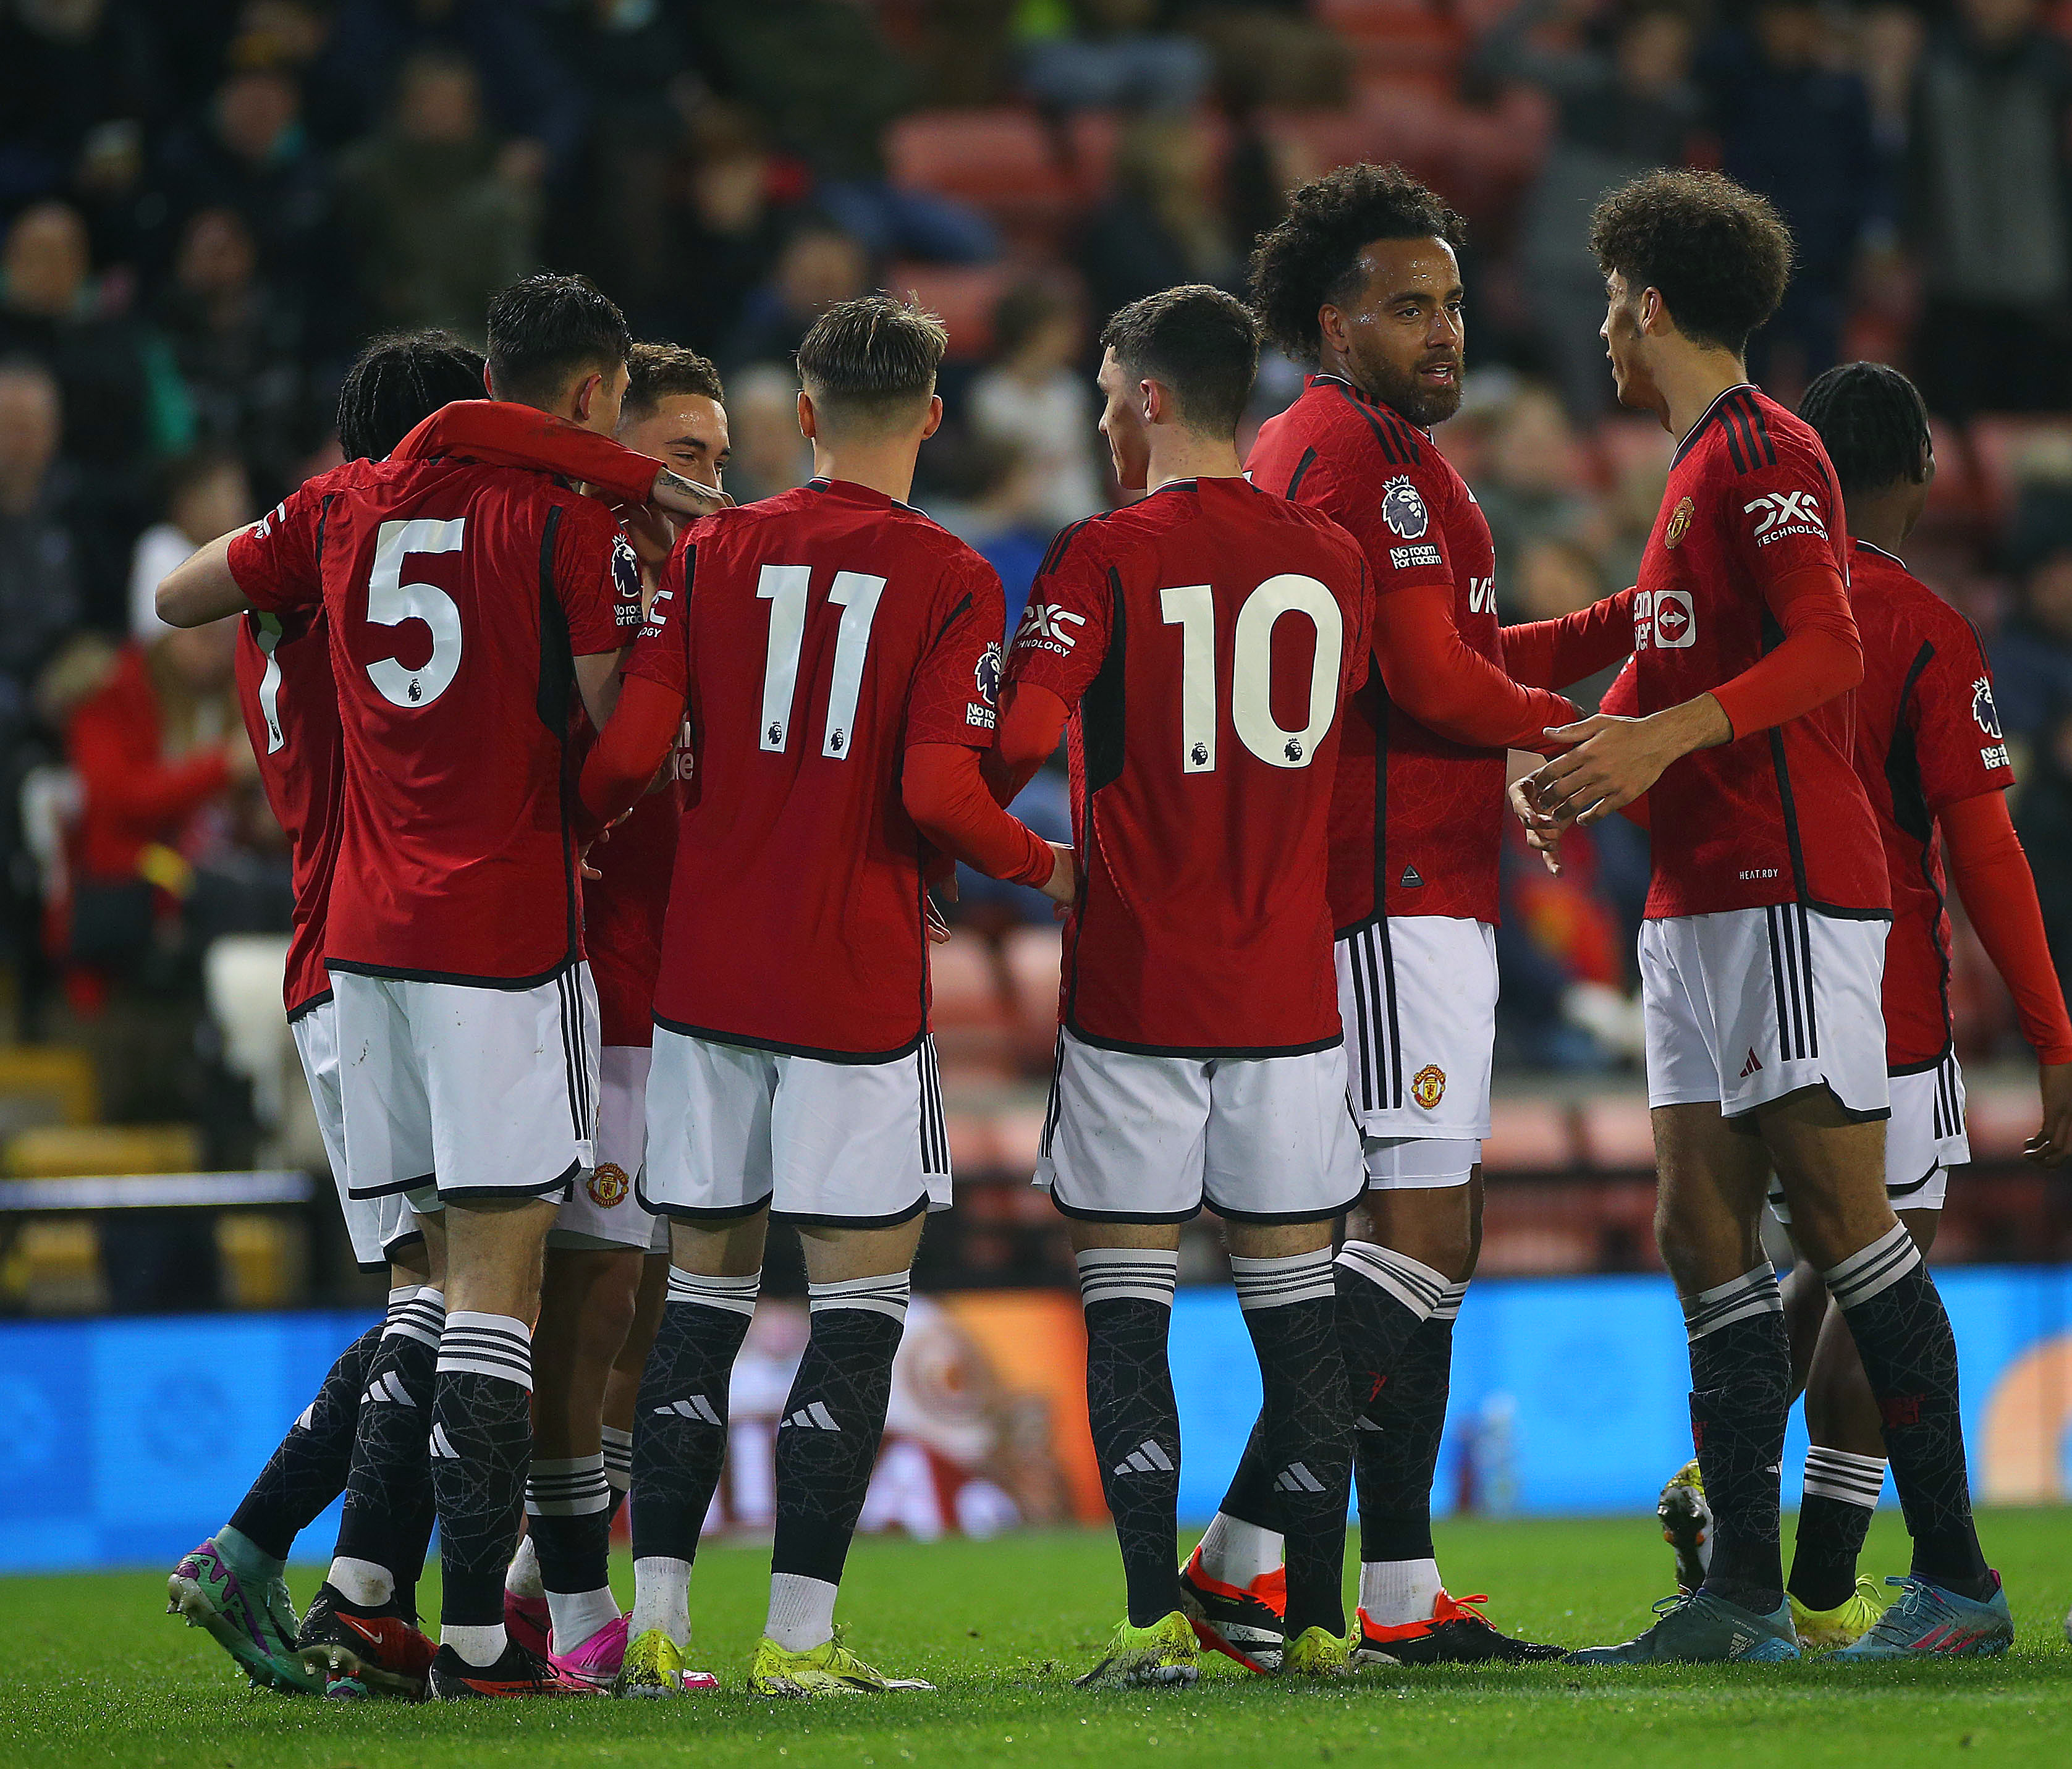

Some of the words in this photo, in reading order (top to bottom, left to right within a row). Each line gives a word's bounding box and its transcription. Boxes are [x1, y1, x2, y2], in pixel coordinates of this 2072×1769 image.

[1390, 547, 1408, 560] No
[1409, 546, 1436, 557] room
[366, 518, 466, 707] 5
[756, 564, 887, 761] 11
[1160, 573, 1343, 774] 10
[967, 702, 984, 716] No
[1740, 869, 1778, 880] HEAT.RDY
[595, 1166, 627, 1183] ANCHESTER
[594, 1196, 619, 1205] UNITED
